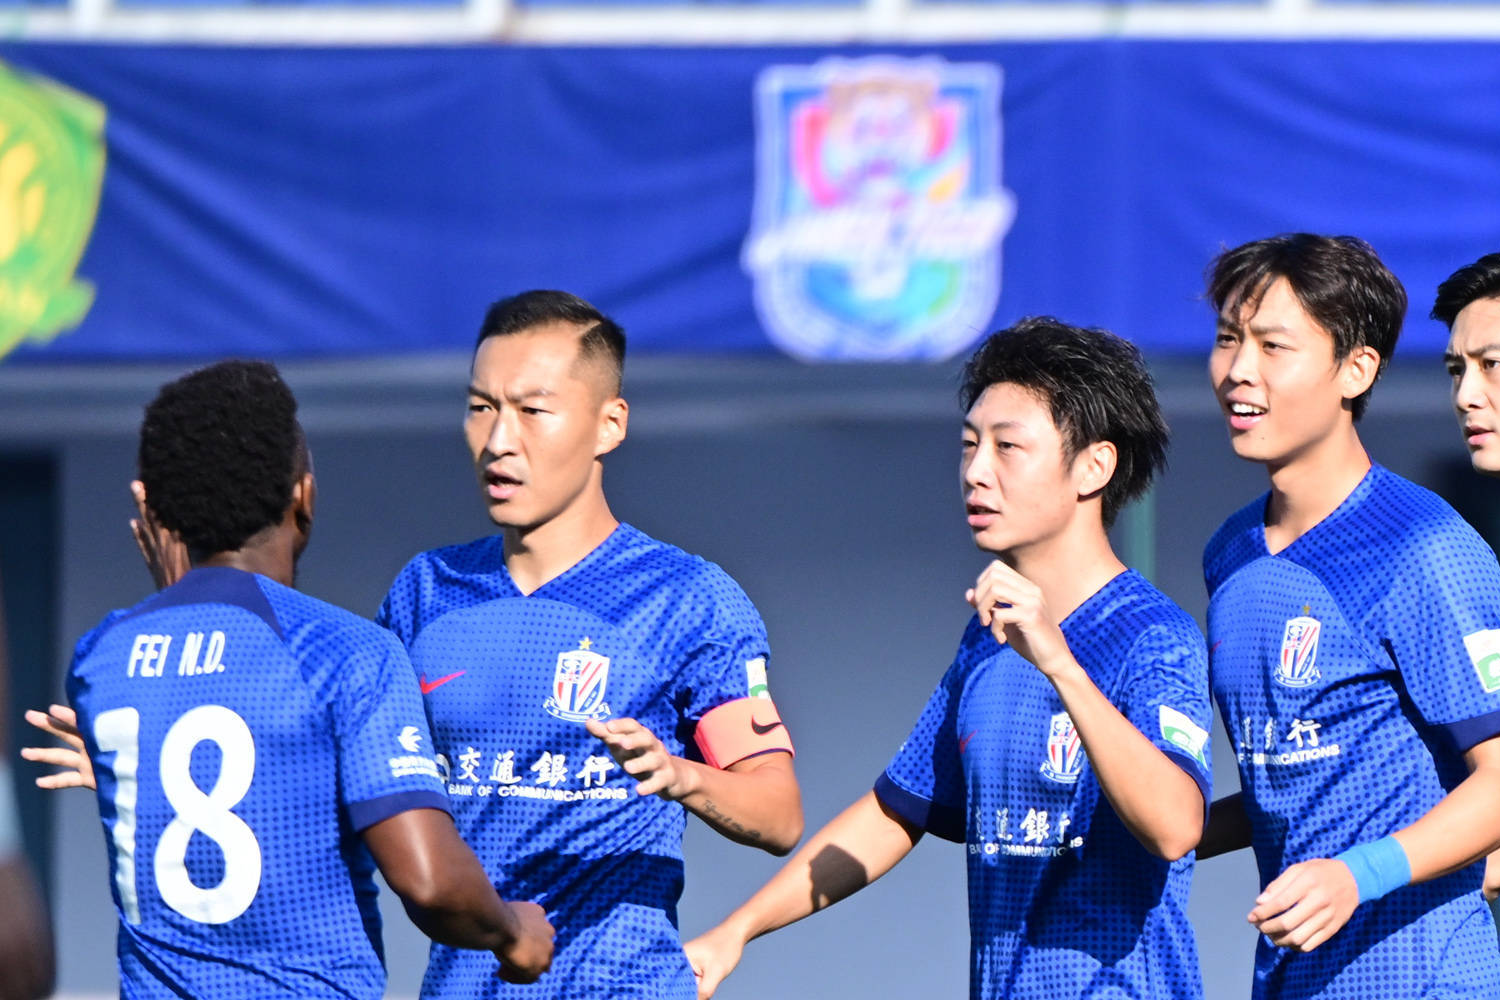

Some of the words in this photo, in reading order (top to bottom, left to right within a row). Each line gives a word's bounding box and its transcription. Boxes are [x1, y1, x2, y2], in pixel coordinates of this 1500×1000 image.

[127, 634, 173, 678] FEI
[178, 630, 226, 676] N.D.
[457, 746, 615, 788] 交通銀行
[93, 704, 262, 925] 18
[477, 785, 493, 798] OF
[498, 785, 628, 802] COMMUNICATIONS
